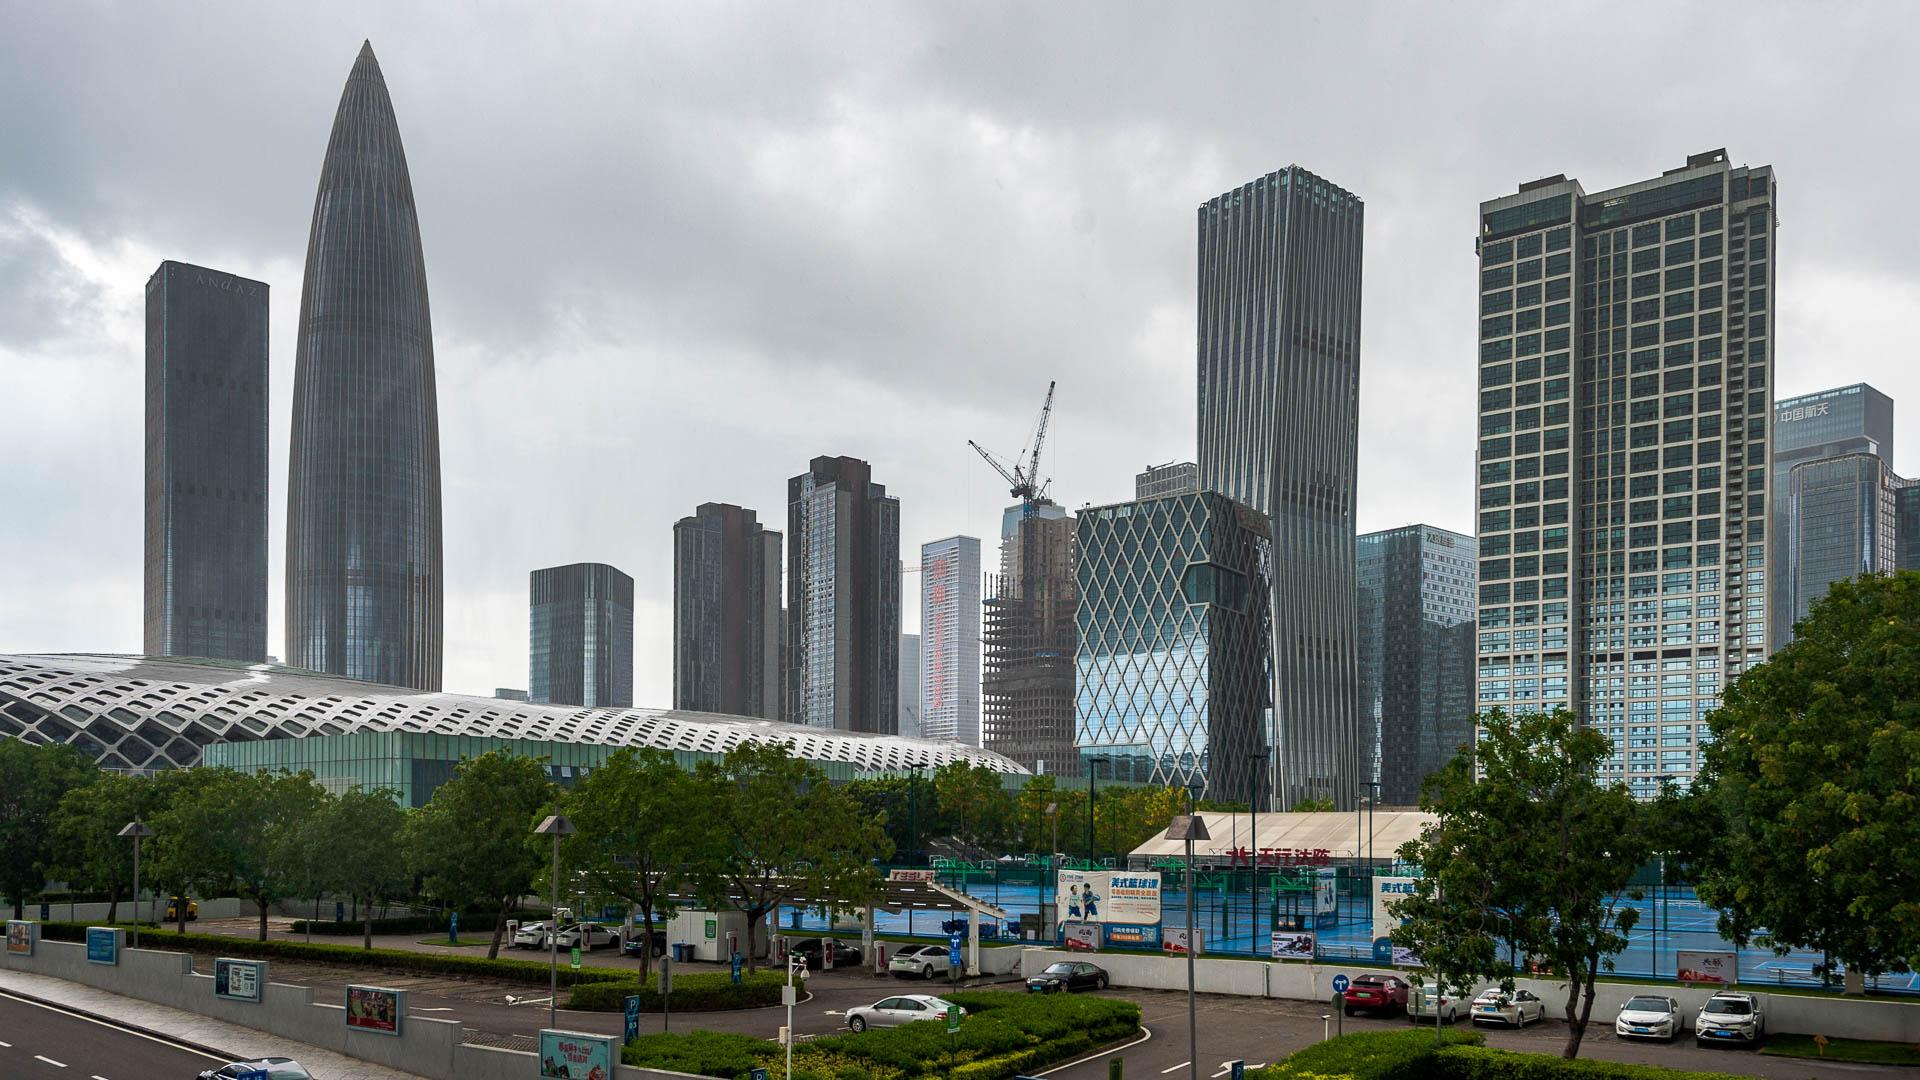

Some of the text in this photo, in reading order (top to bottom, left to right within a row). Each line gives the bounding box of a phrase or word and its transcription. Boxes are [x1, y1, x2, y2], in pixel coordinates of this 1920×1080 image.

[1781, 402, 1829, 423] 中国航天
[1257, 847, 1331, 867] 天行达阵
[891, 870, 934, 881] TESLA
[1111, 877, 1159, 889] 美式篮球课
[630, 999, 636, 1010] P
